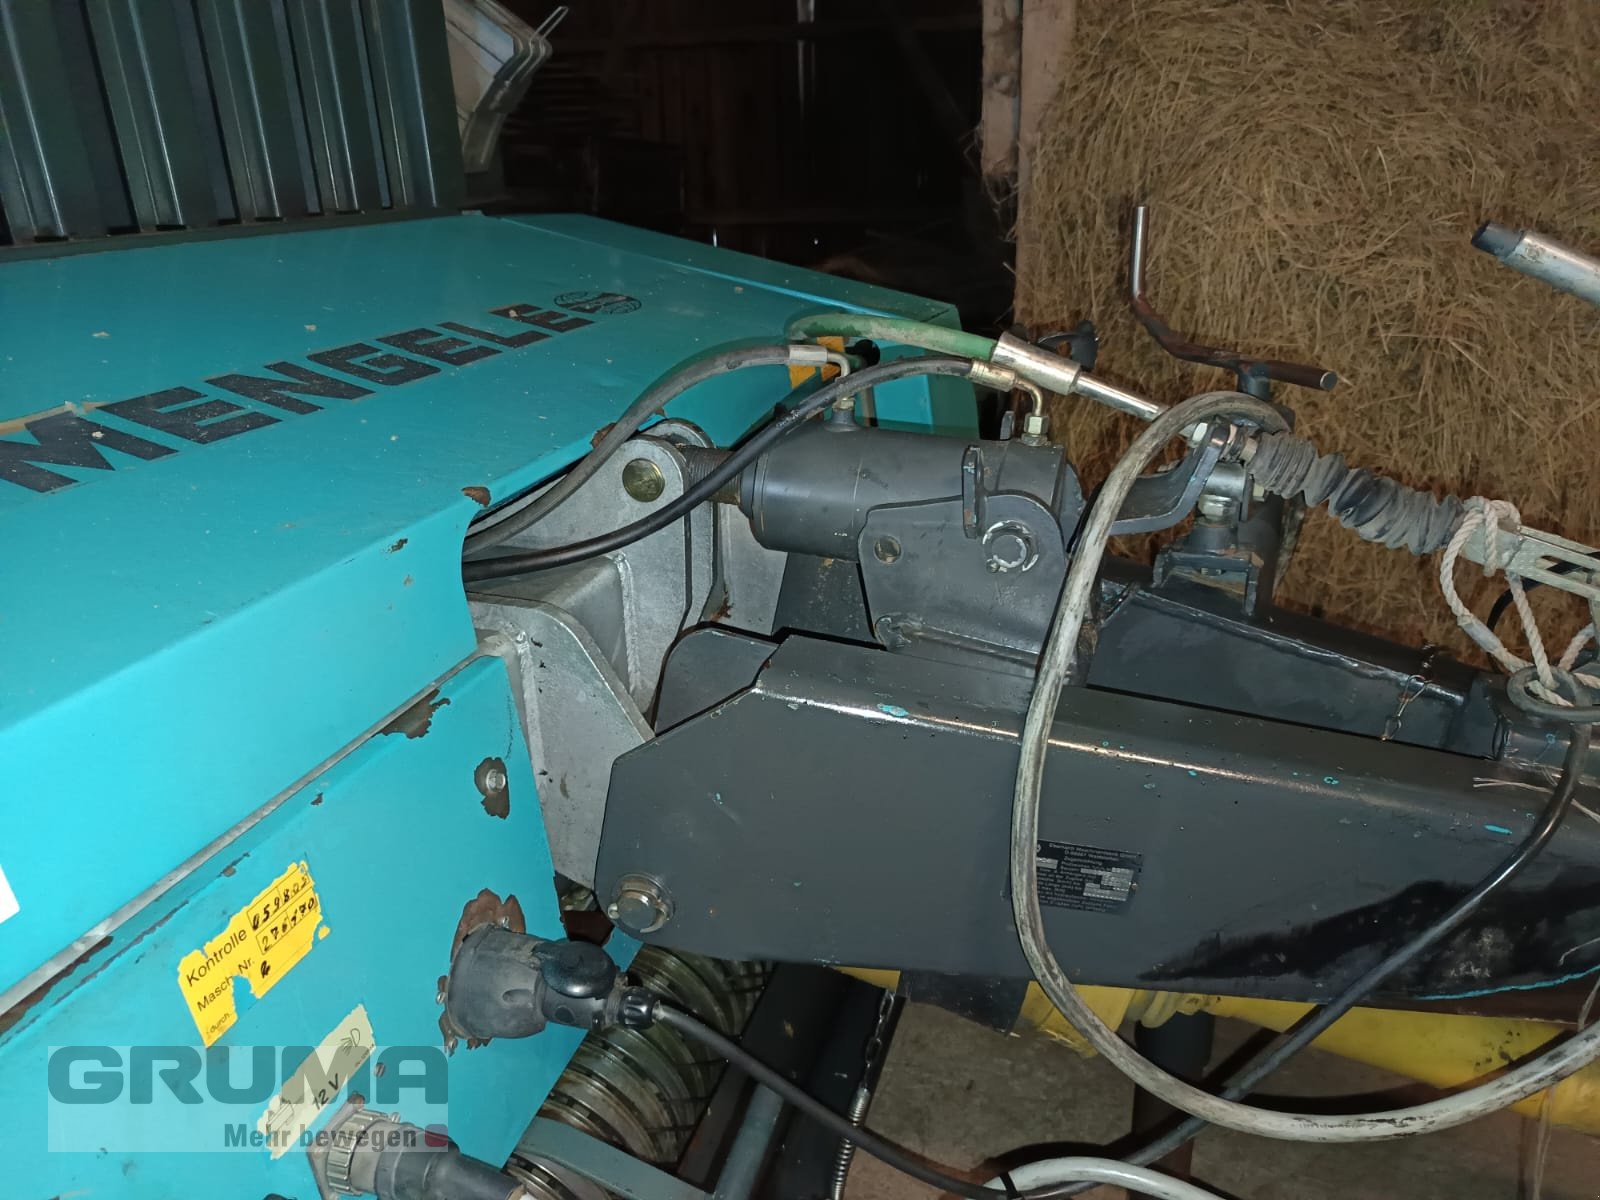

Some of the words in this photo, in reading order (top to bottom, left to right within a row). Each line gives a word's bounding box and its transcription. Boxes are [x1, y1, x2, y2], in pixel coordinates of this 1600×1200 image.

[0, 303, 595, 493] MENGELE
[186, 928, 248, 987] Kontrolle
[238, 957, 256, 975] Nr.
[312, 1088, 329, 1110] 12
